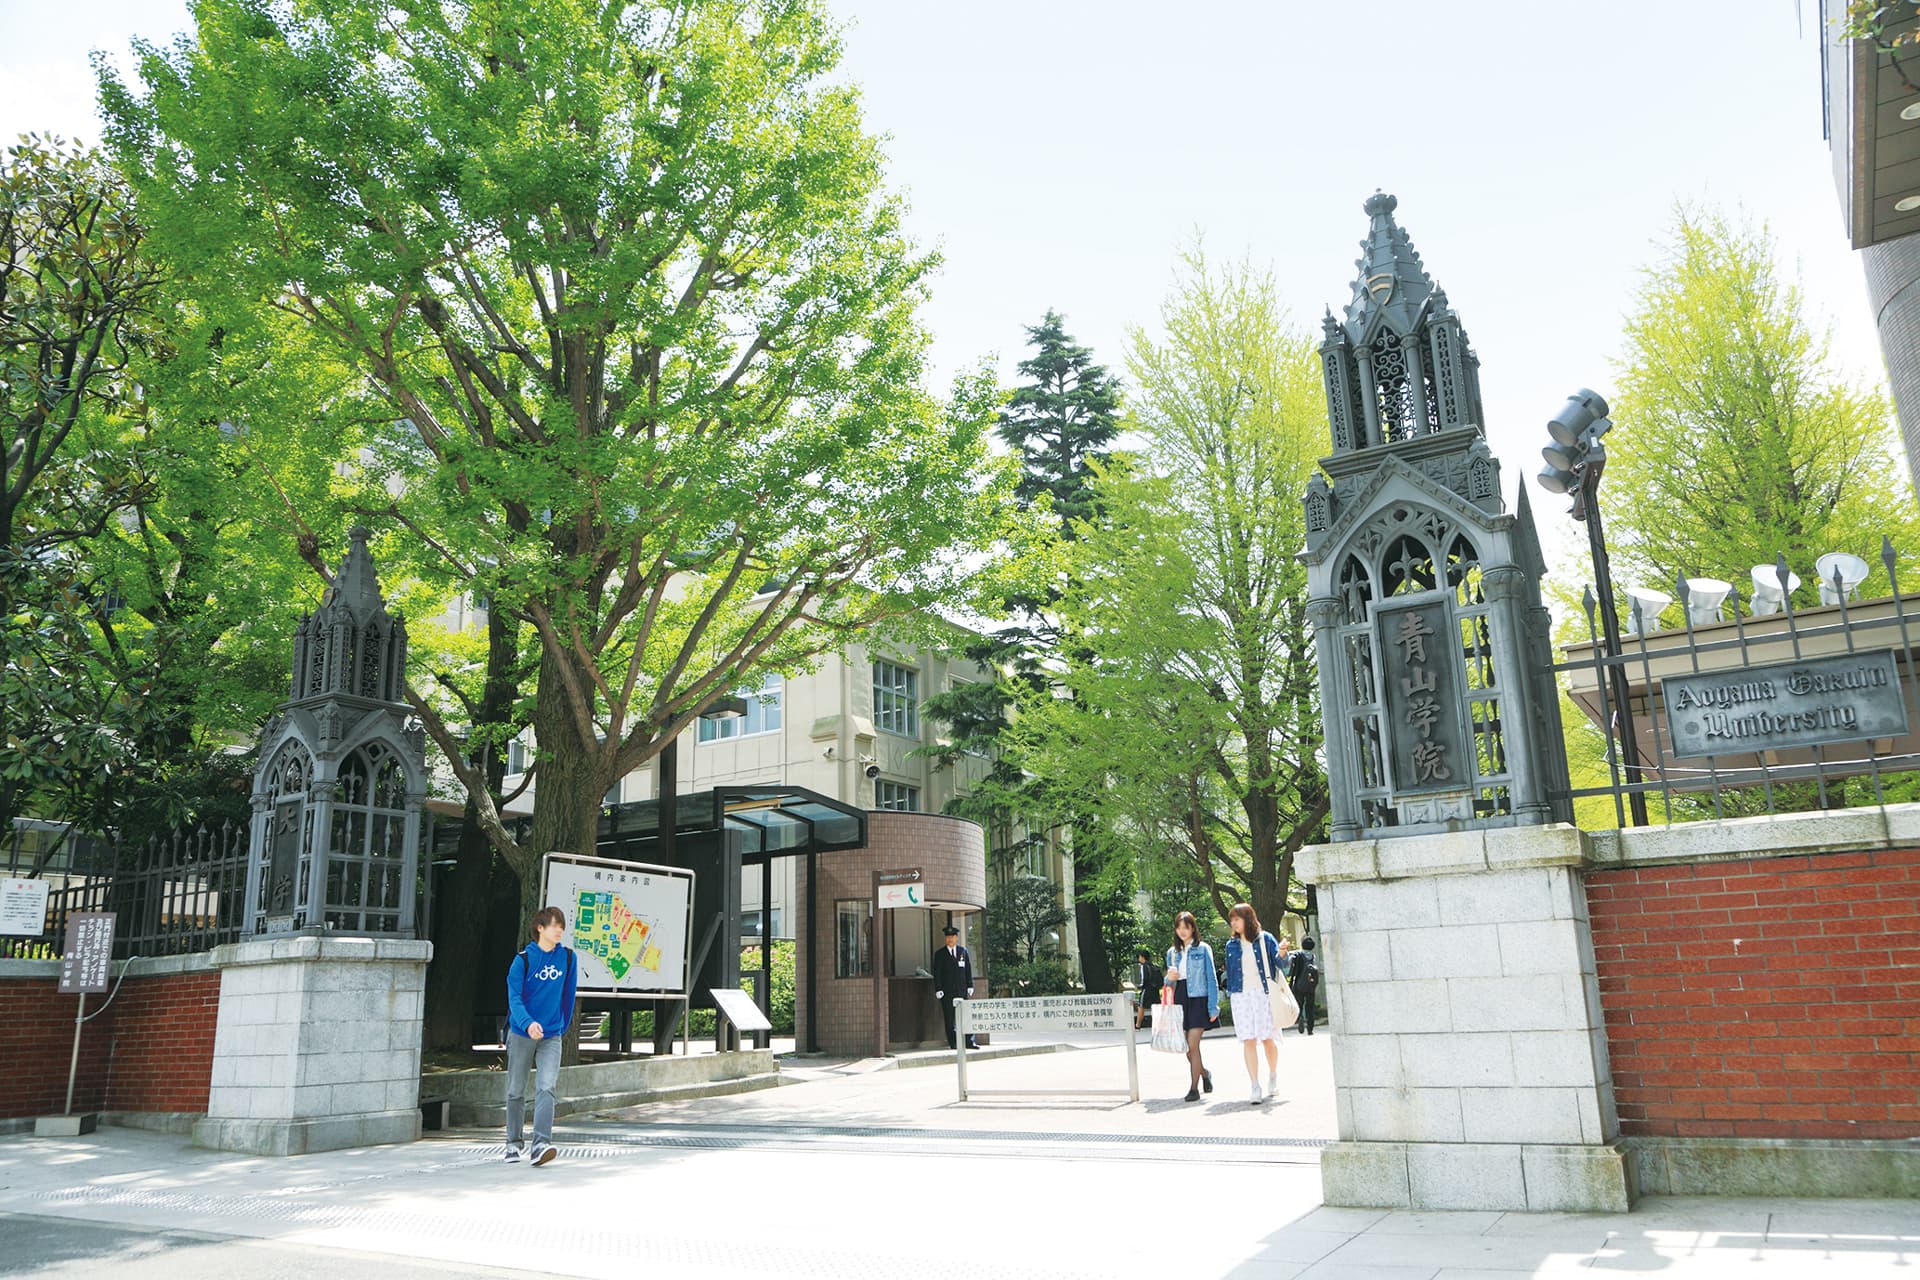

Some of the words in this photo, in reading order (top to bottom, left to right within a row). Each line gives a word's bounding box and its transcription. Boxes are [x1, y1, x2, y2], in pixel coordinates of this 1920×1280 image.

[1393, 611, 1450, 786] 青山学院
[1675, 679, 1777, 711] Aoyama
[1785, 663, 1889, 696] Gakuin
[1703, 703, 1858, 740] University
[273, 806, 298, 910] 大学
